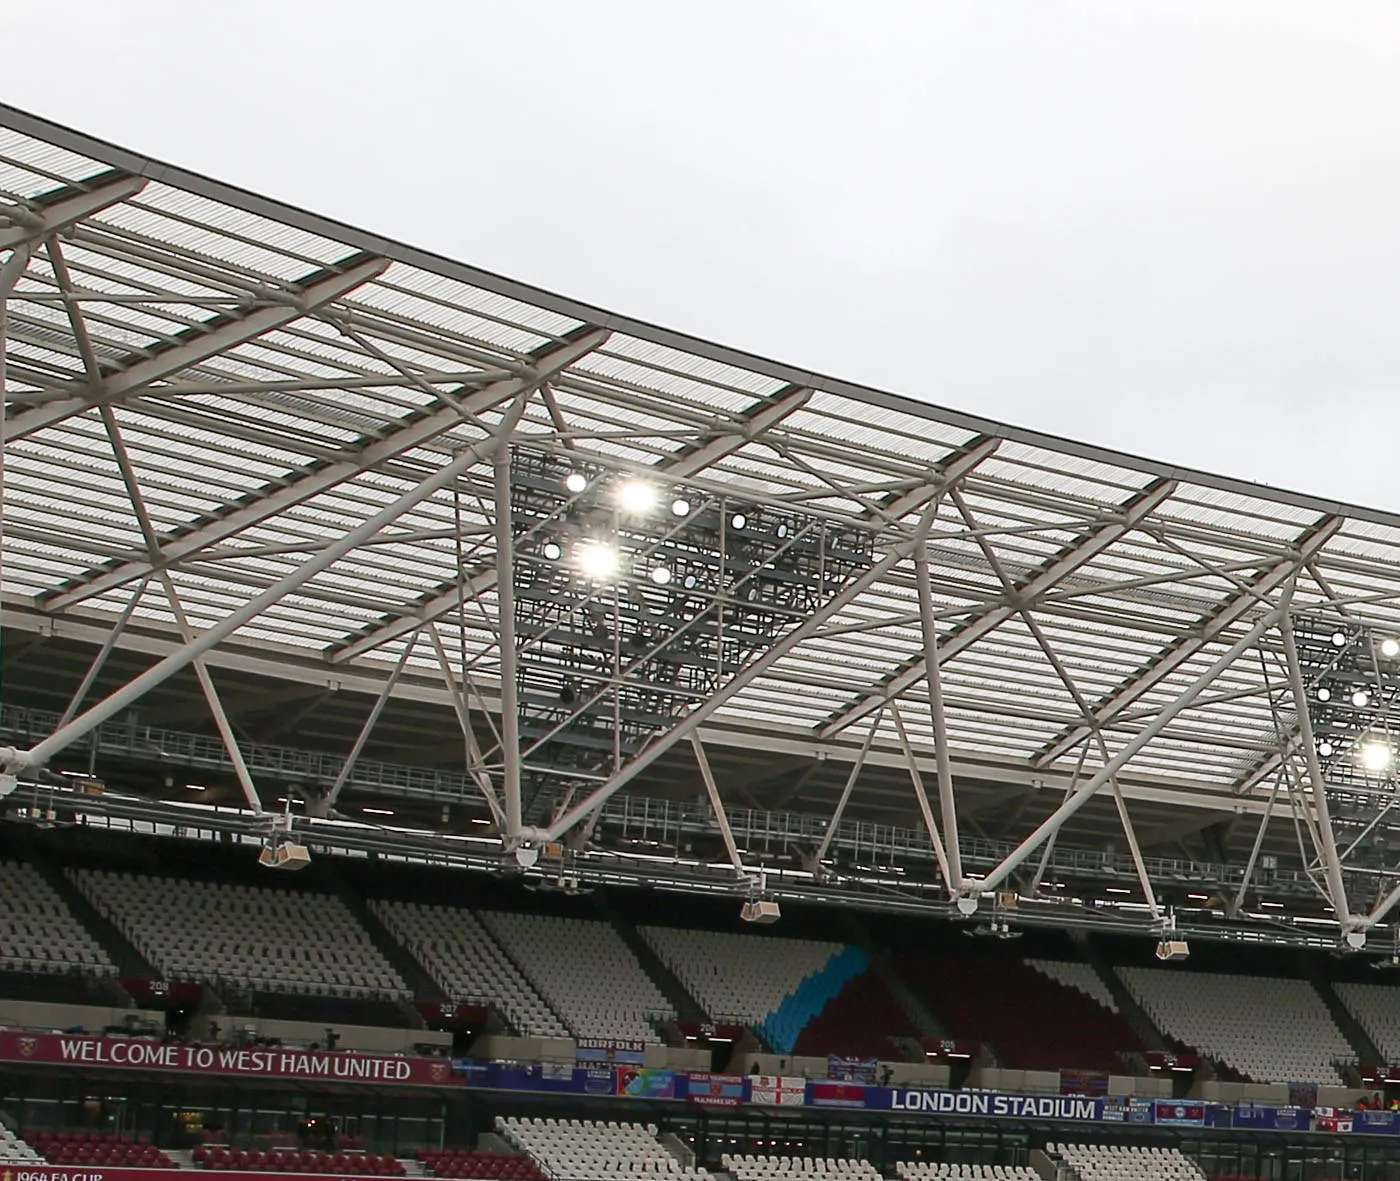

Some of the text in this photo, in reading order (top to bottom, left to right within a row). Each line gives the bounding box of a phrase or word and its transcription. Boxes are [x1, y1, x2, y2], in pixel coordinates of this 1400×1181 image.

[578, 1038, 644, 1050] NORFOLK
[60, 1039, 410, 1080] WELCOME TO WEST HAM UNITED
[892, 1090, 988, 1114] LONDON
[994, 1097, 1095, 1119] STADIUM
